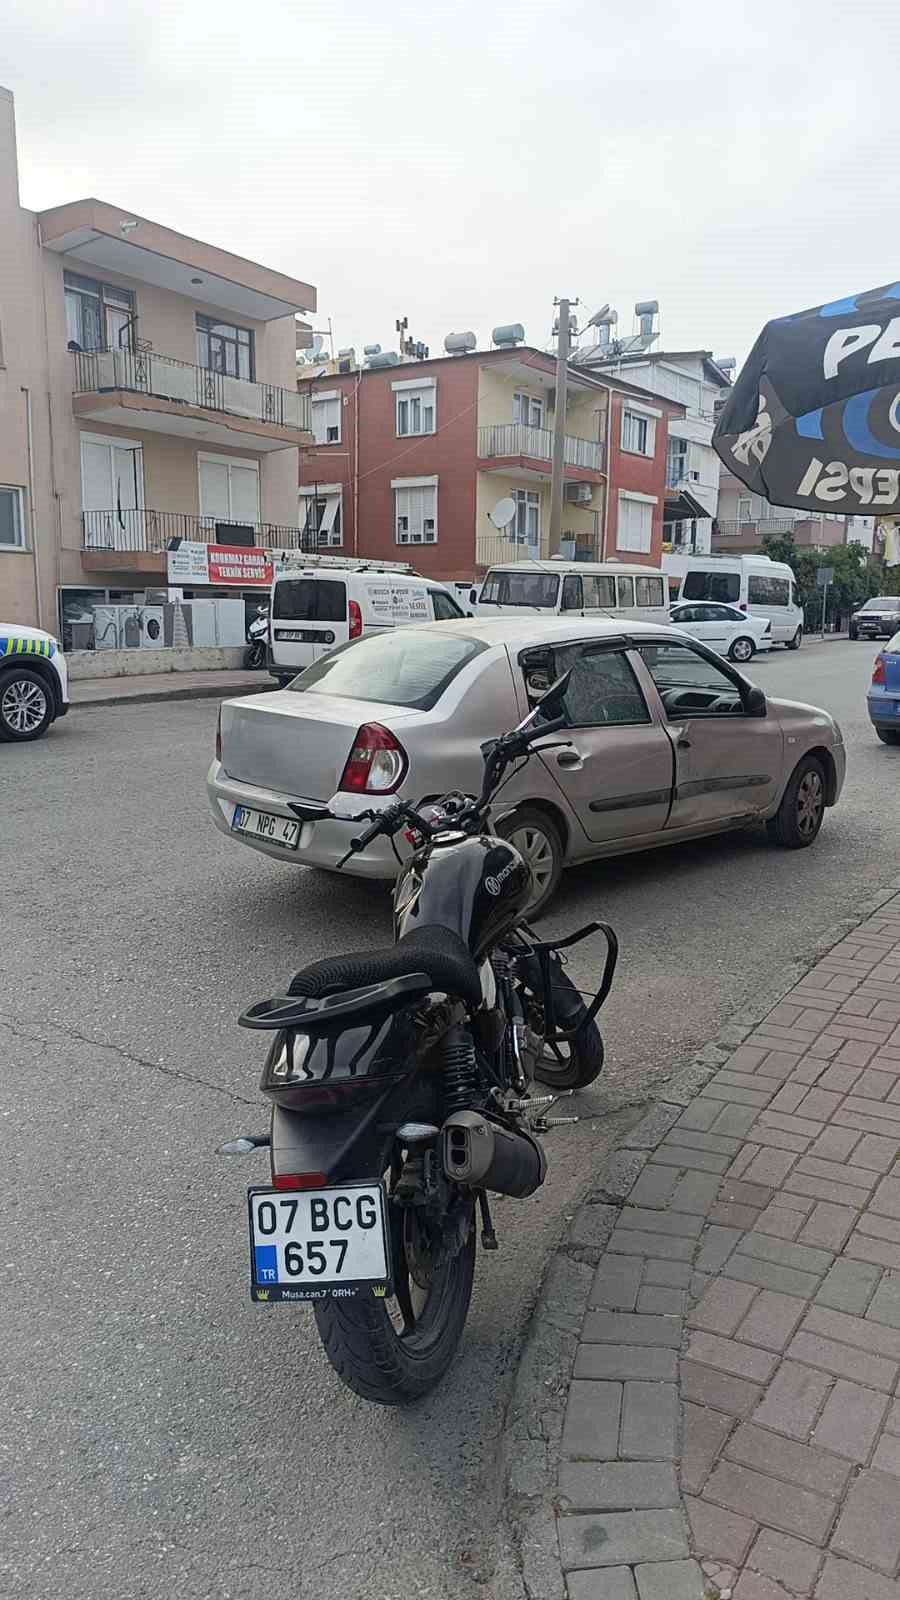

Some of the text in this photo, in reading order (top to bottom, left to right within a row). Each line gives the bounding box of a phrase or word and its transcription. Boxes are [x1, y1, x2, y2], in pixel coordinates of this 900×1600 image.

[239, 810, 251, 828] 07
[256, 814, 276, 836] NPG
[282, 822, 298, 841] 47
[257, 1194, 377, 1235] 07 BCG
[262, 1268, 276, 1280] TR
[284, 1239, 348, 1276] 657
